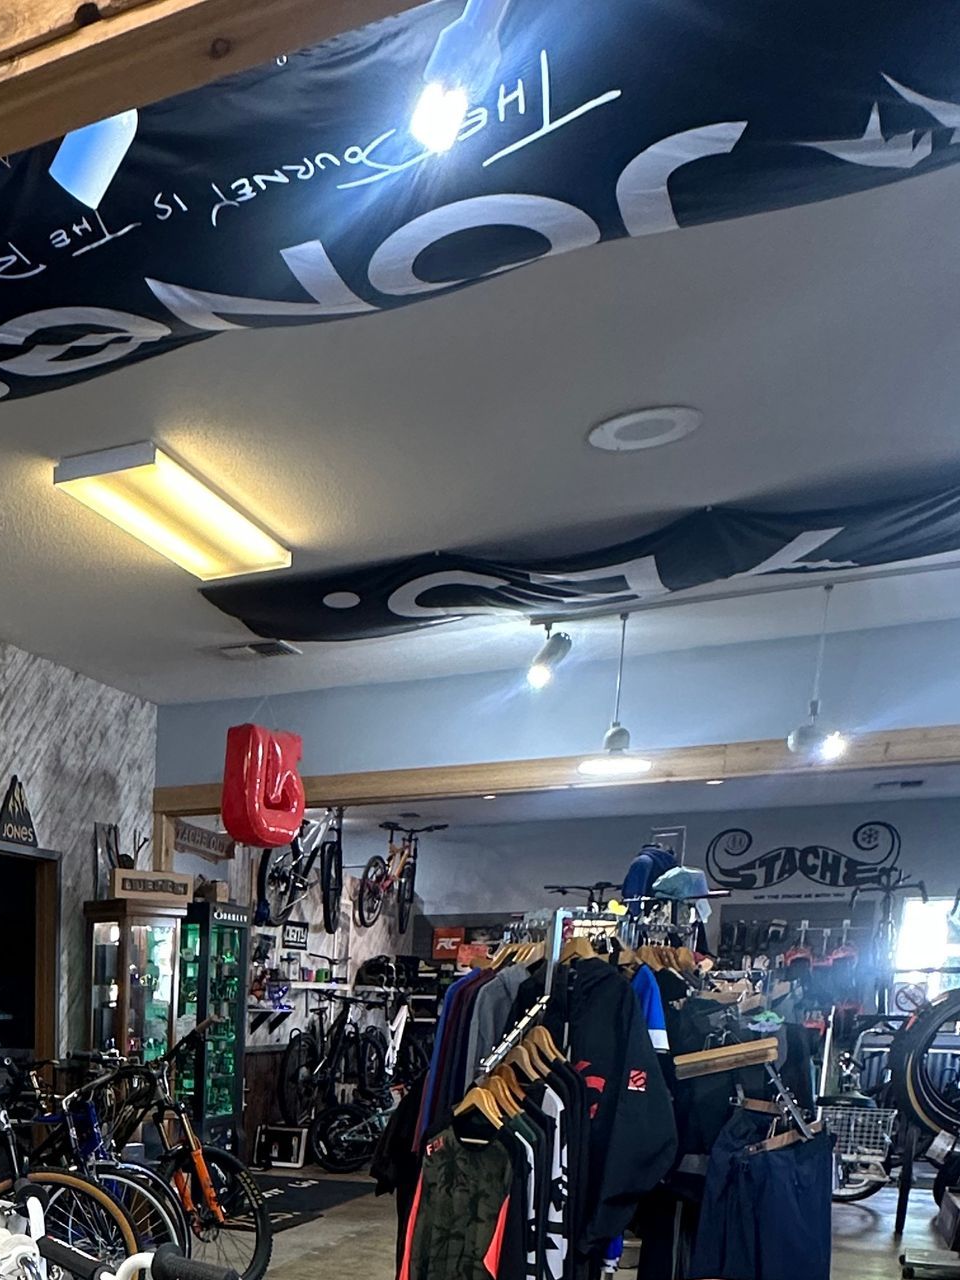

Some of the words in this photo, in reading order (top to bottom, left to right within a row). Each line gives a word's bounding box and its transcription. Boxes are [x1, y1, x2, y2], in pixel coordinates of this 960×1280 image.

[153, 193, 190, 221] IS
[49, 209, 142, 258] THE
[712, 846, 882, 889] STACHE
